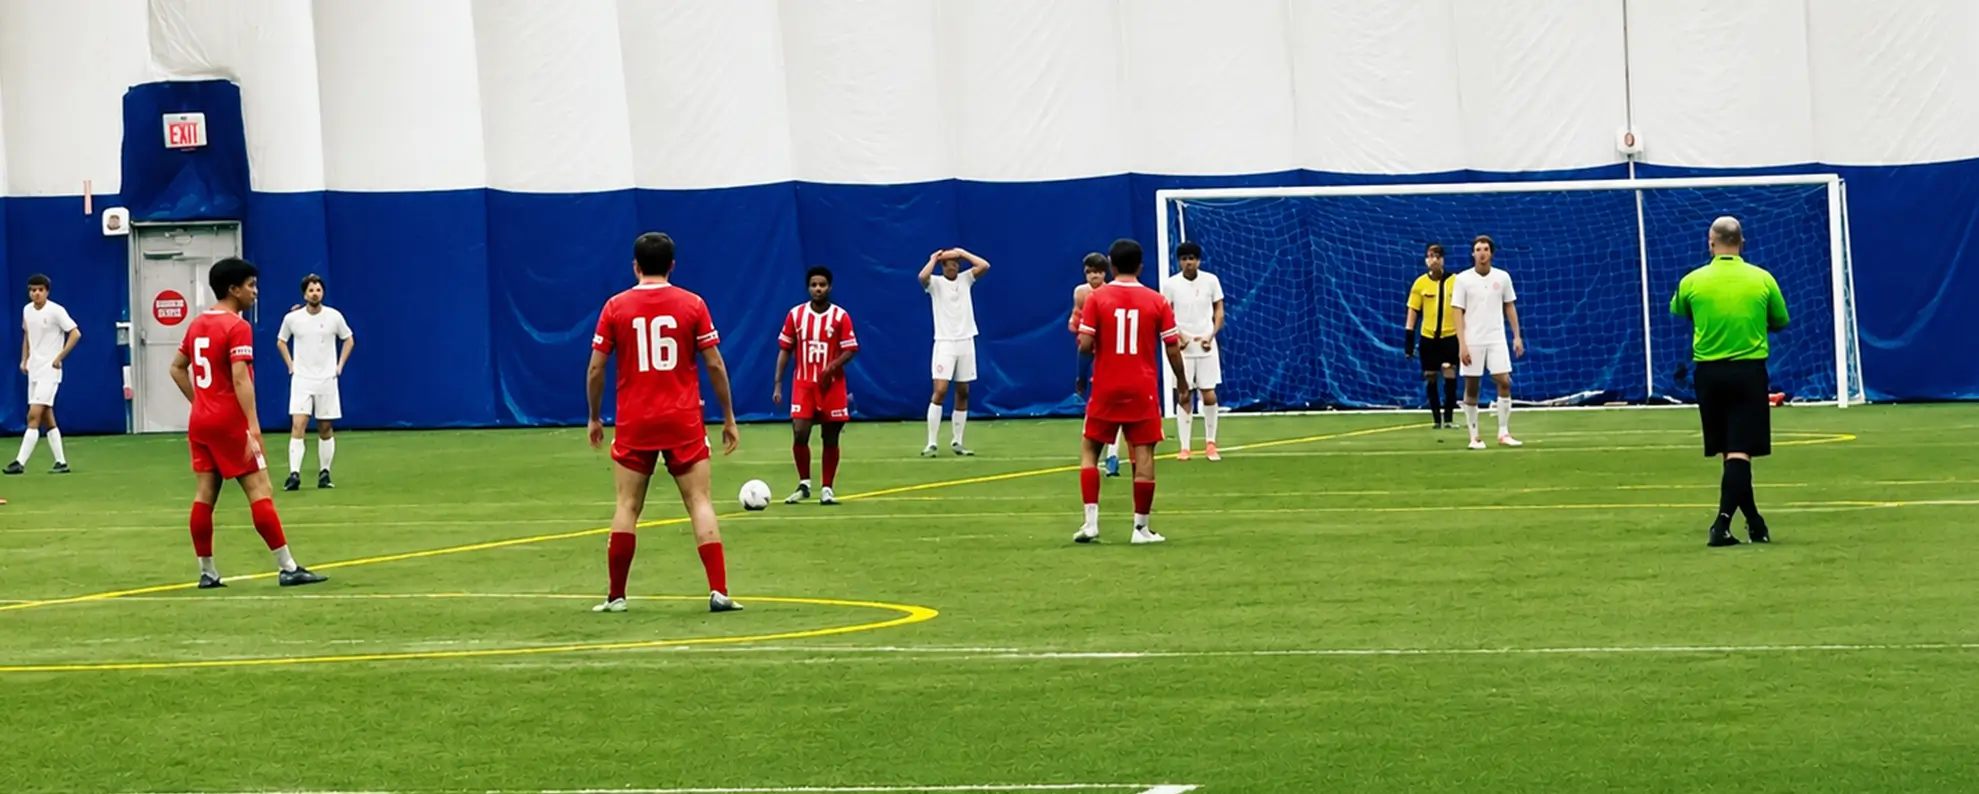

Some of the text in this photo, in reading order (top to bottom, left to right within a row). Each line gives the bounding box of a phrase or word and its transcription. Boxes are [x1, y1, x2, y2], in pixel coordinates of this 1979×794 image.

[169, 122, 198, 146] EXIT
[632, 315, 678, 372] 16
[1114, 308, 1139, 355] 11
[194, 337, 212, 389] 5
